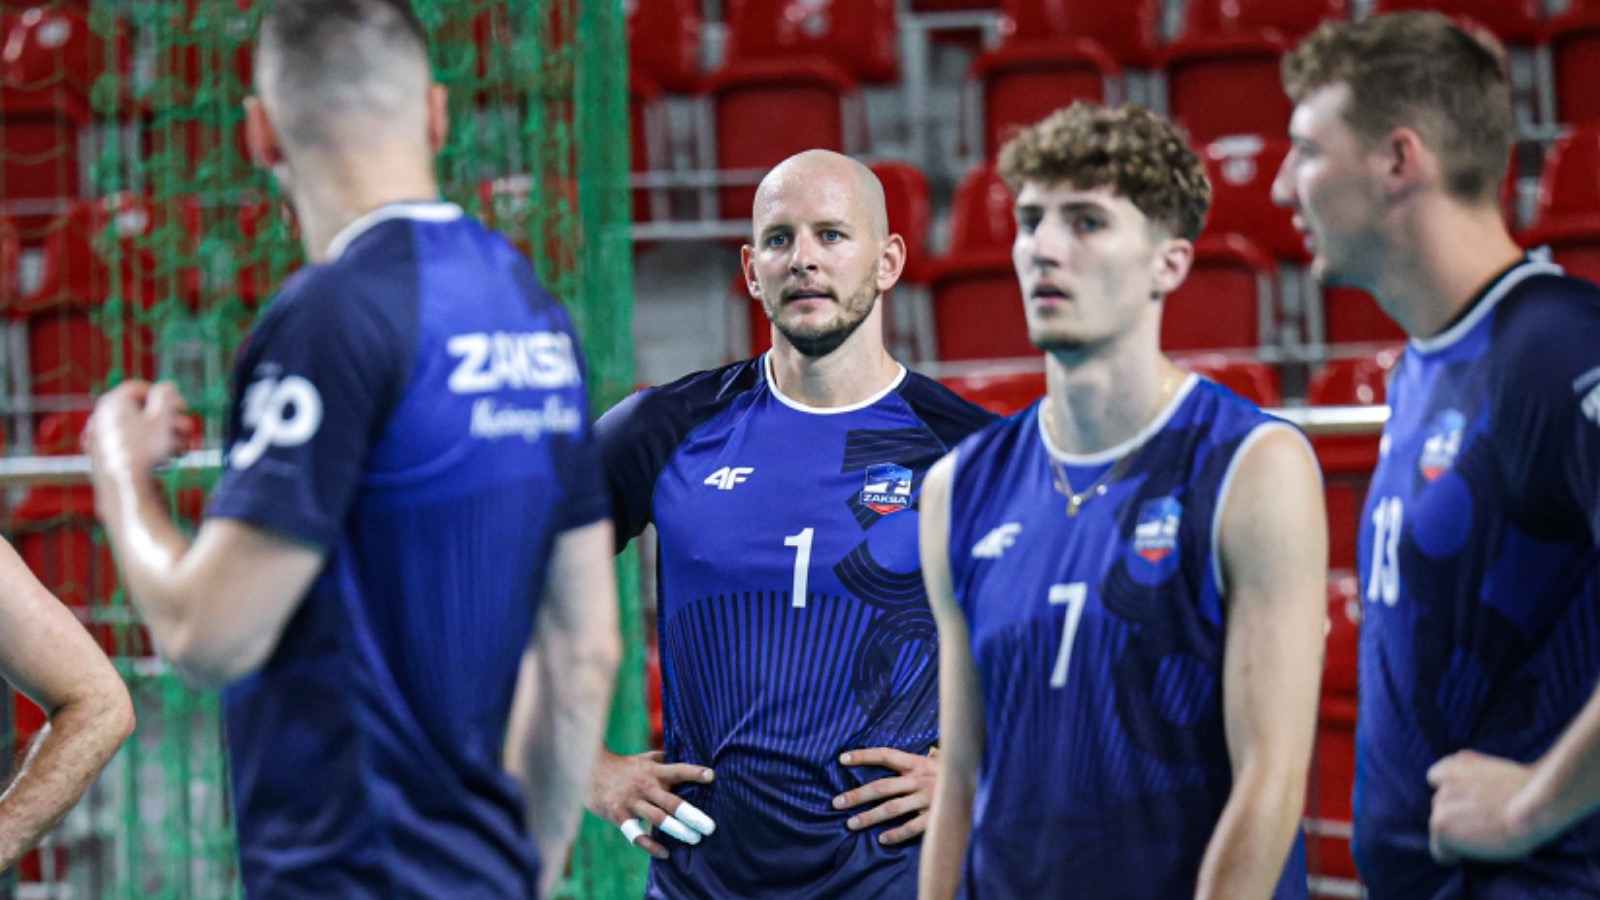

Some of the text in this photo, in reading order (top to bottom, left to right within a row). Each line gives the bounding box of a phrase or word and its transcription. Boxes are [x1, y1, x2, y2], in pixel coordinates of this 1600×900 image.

[703, 466, 755, 490] 4F
[863, 494, 907, 506] ZAKSA
[783, 527, 814, 608] 1
[1368, 496, 1404, 606] 13
[1048, 582, 1088, 688] 7
